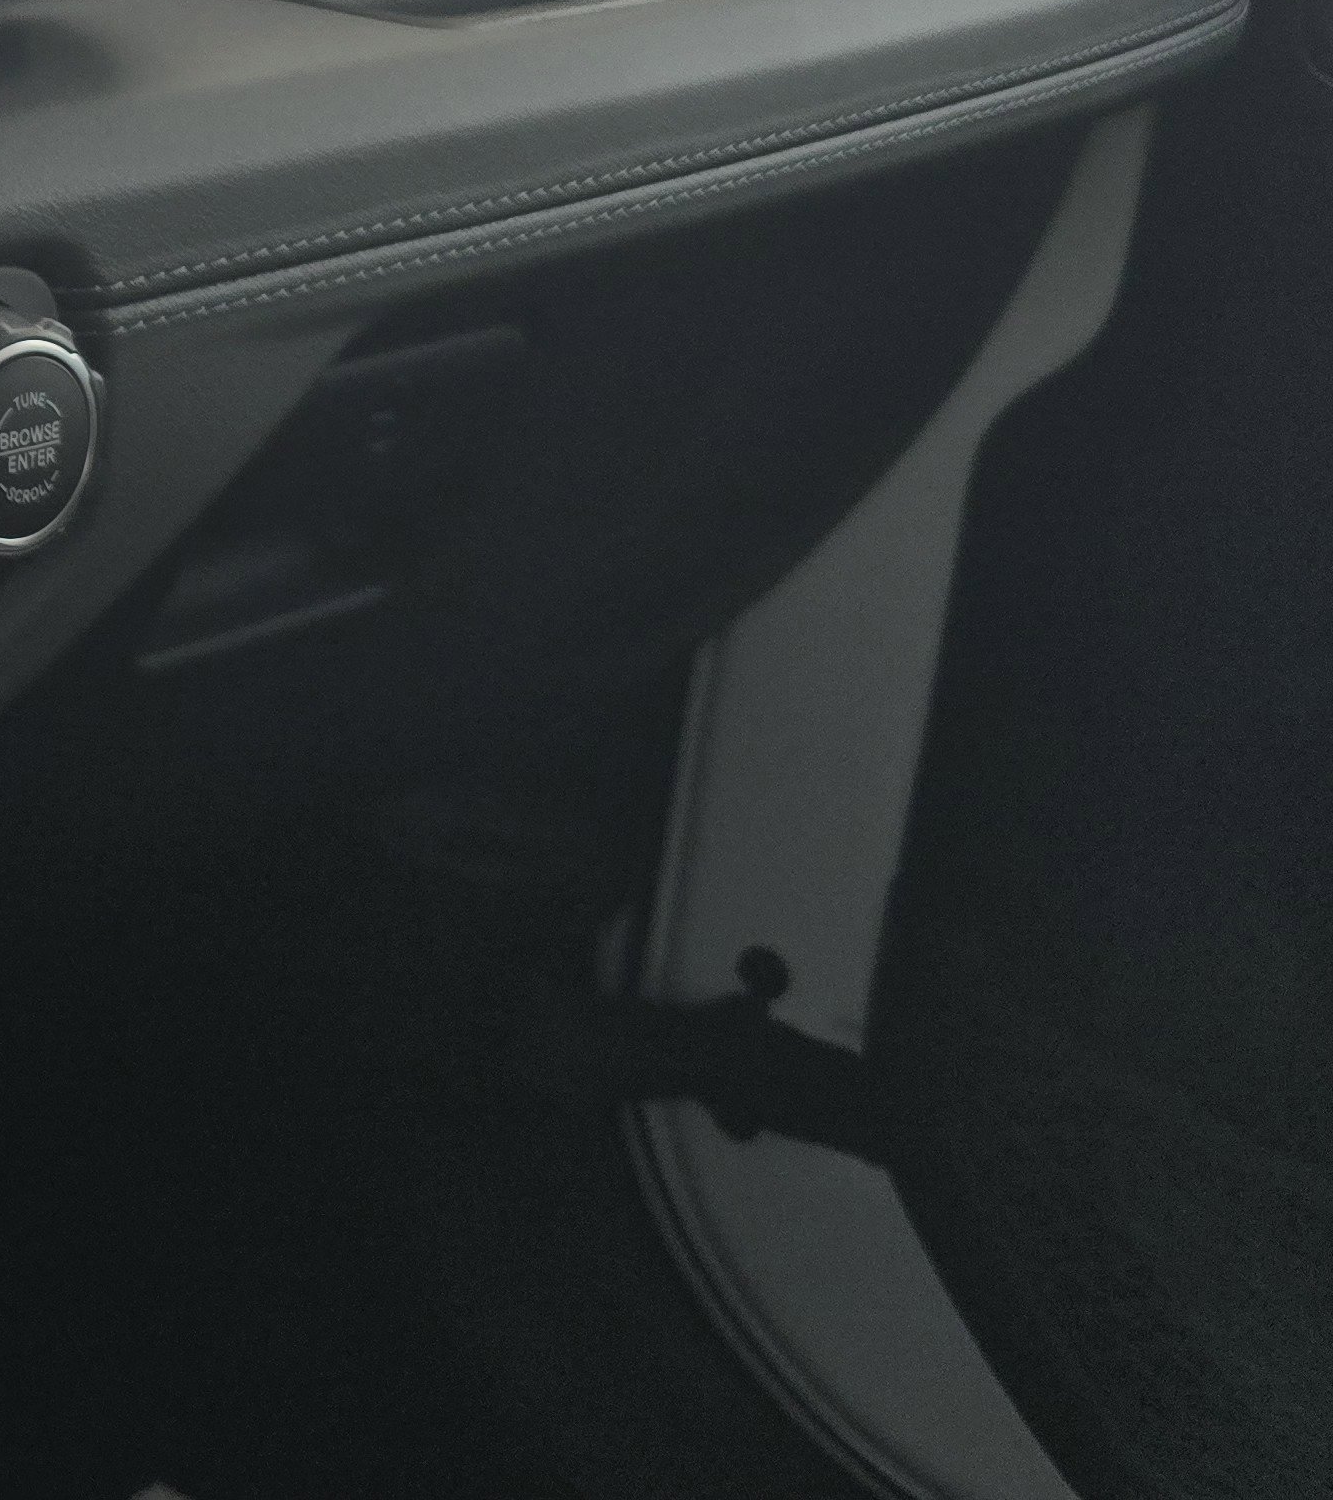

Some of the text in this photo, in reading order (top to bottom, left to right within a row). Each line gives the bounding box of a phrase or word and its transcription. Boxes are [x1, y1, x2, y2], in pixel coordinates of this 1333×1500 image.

[12, 391, 47, 410] TUNE
[0, 420, 61, 450] BROWSE
[7, 447, 57, 473] ENTER
[5, 481, 54, 504] SCROLL
